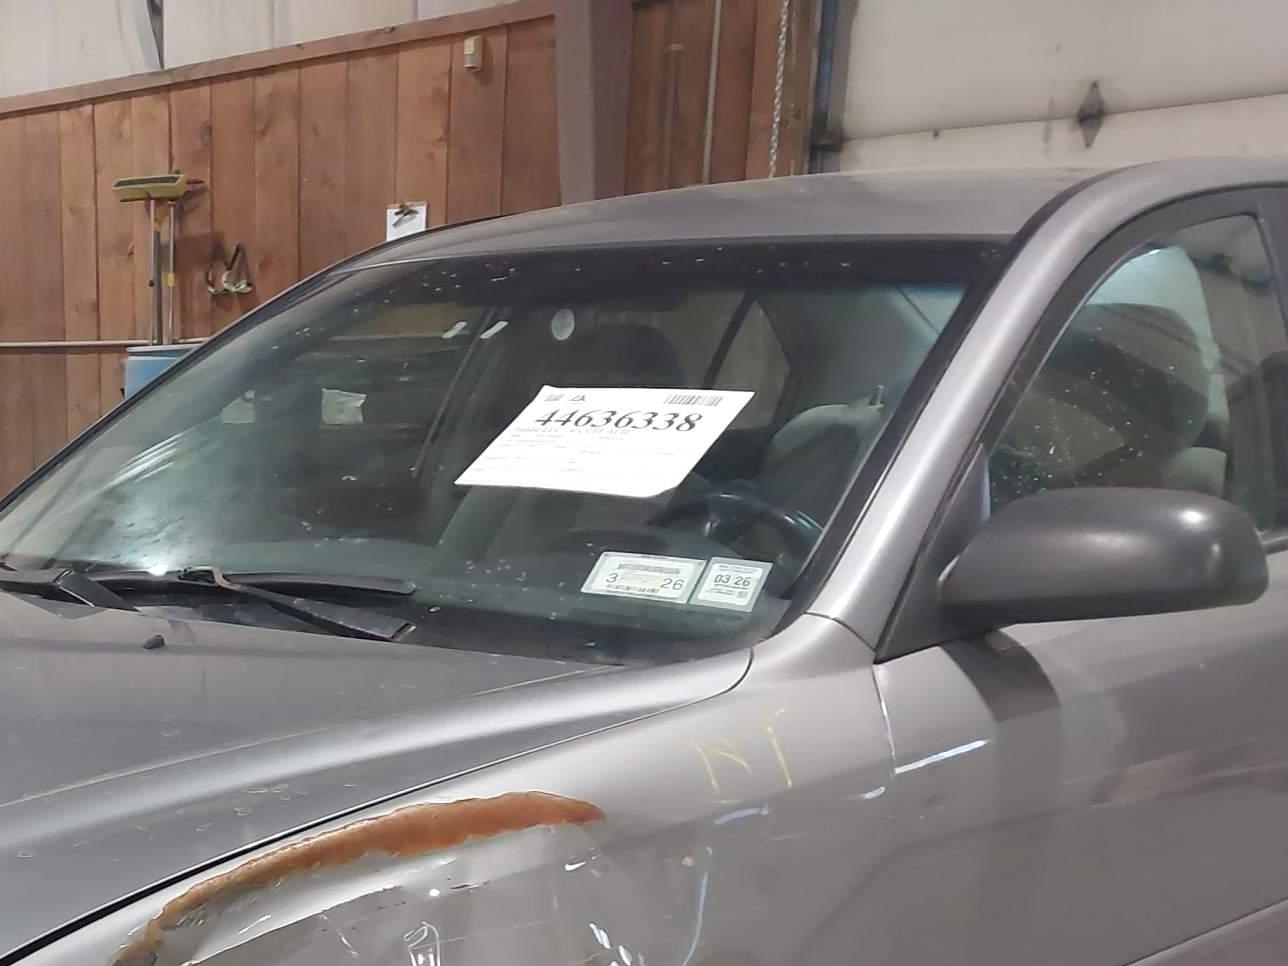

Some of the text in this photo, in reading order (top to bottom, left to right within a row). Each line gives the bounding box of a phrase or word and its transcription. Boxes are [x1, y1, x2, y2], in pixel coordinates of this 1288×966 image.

[535, 409, 703, 432] 44636338
[606, 573, 619, 583] 3
[660, 578, 685, 591] 26
[714, 574, 752, 587] 03 26
